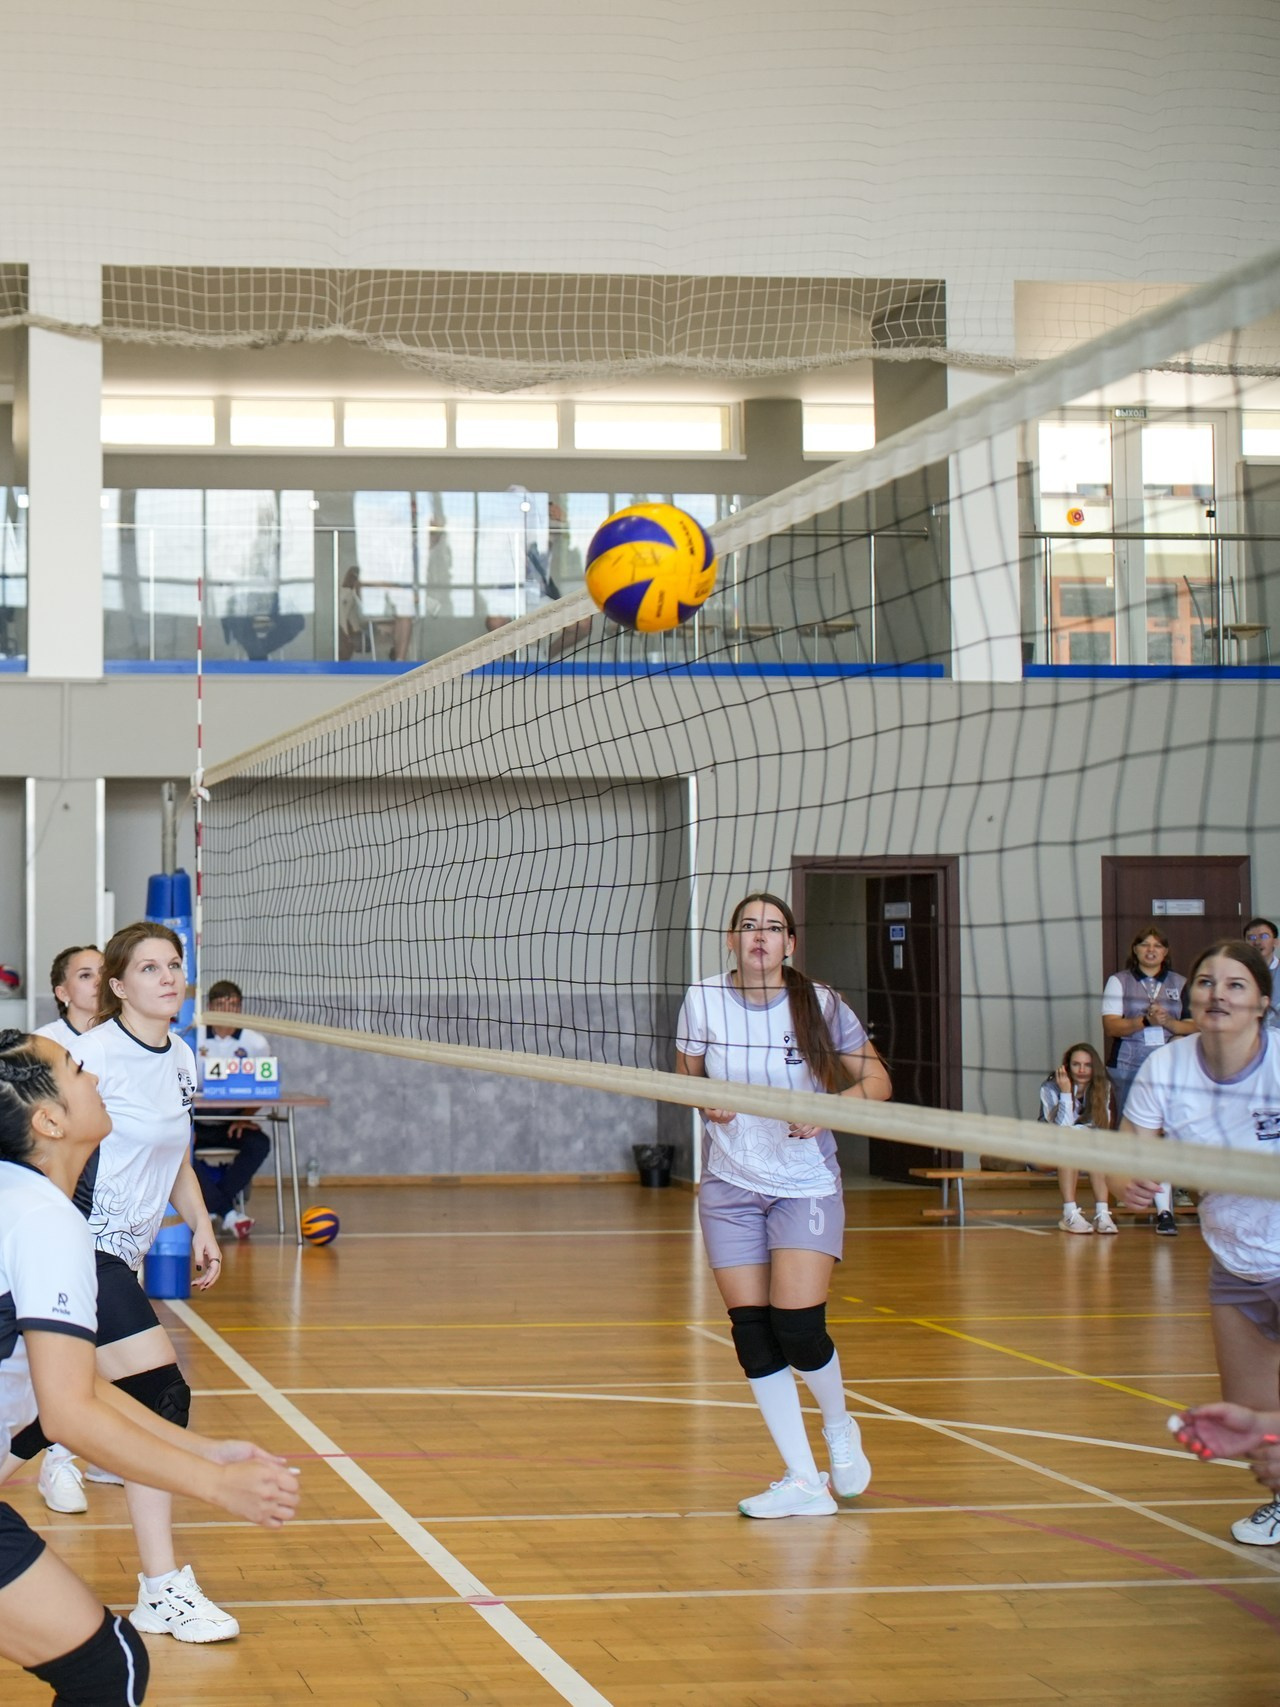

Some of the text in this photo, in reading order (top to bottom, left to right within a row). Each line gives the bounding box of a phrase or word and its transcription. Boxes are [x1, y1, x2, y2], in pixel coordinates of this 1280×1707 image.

[210, 1063, 221, 1078] 4
[260, 1062, 272, 1079] 8
[808, 1196, 825, 1236] 5
